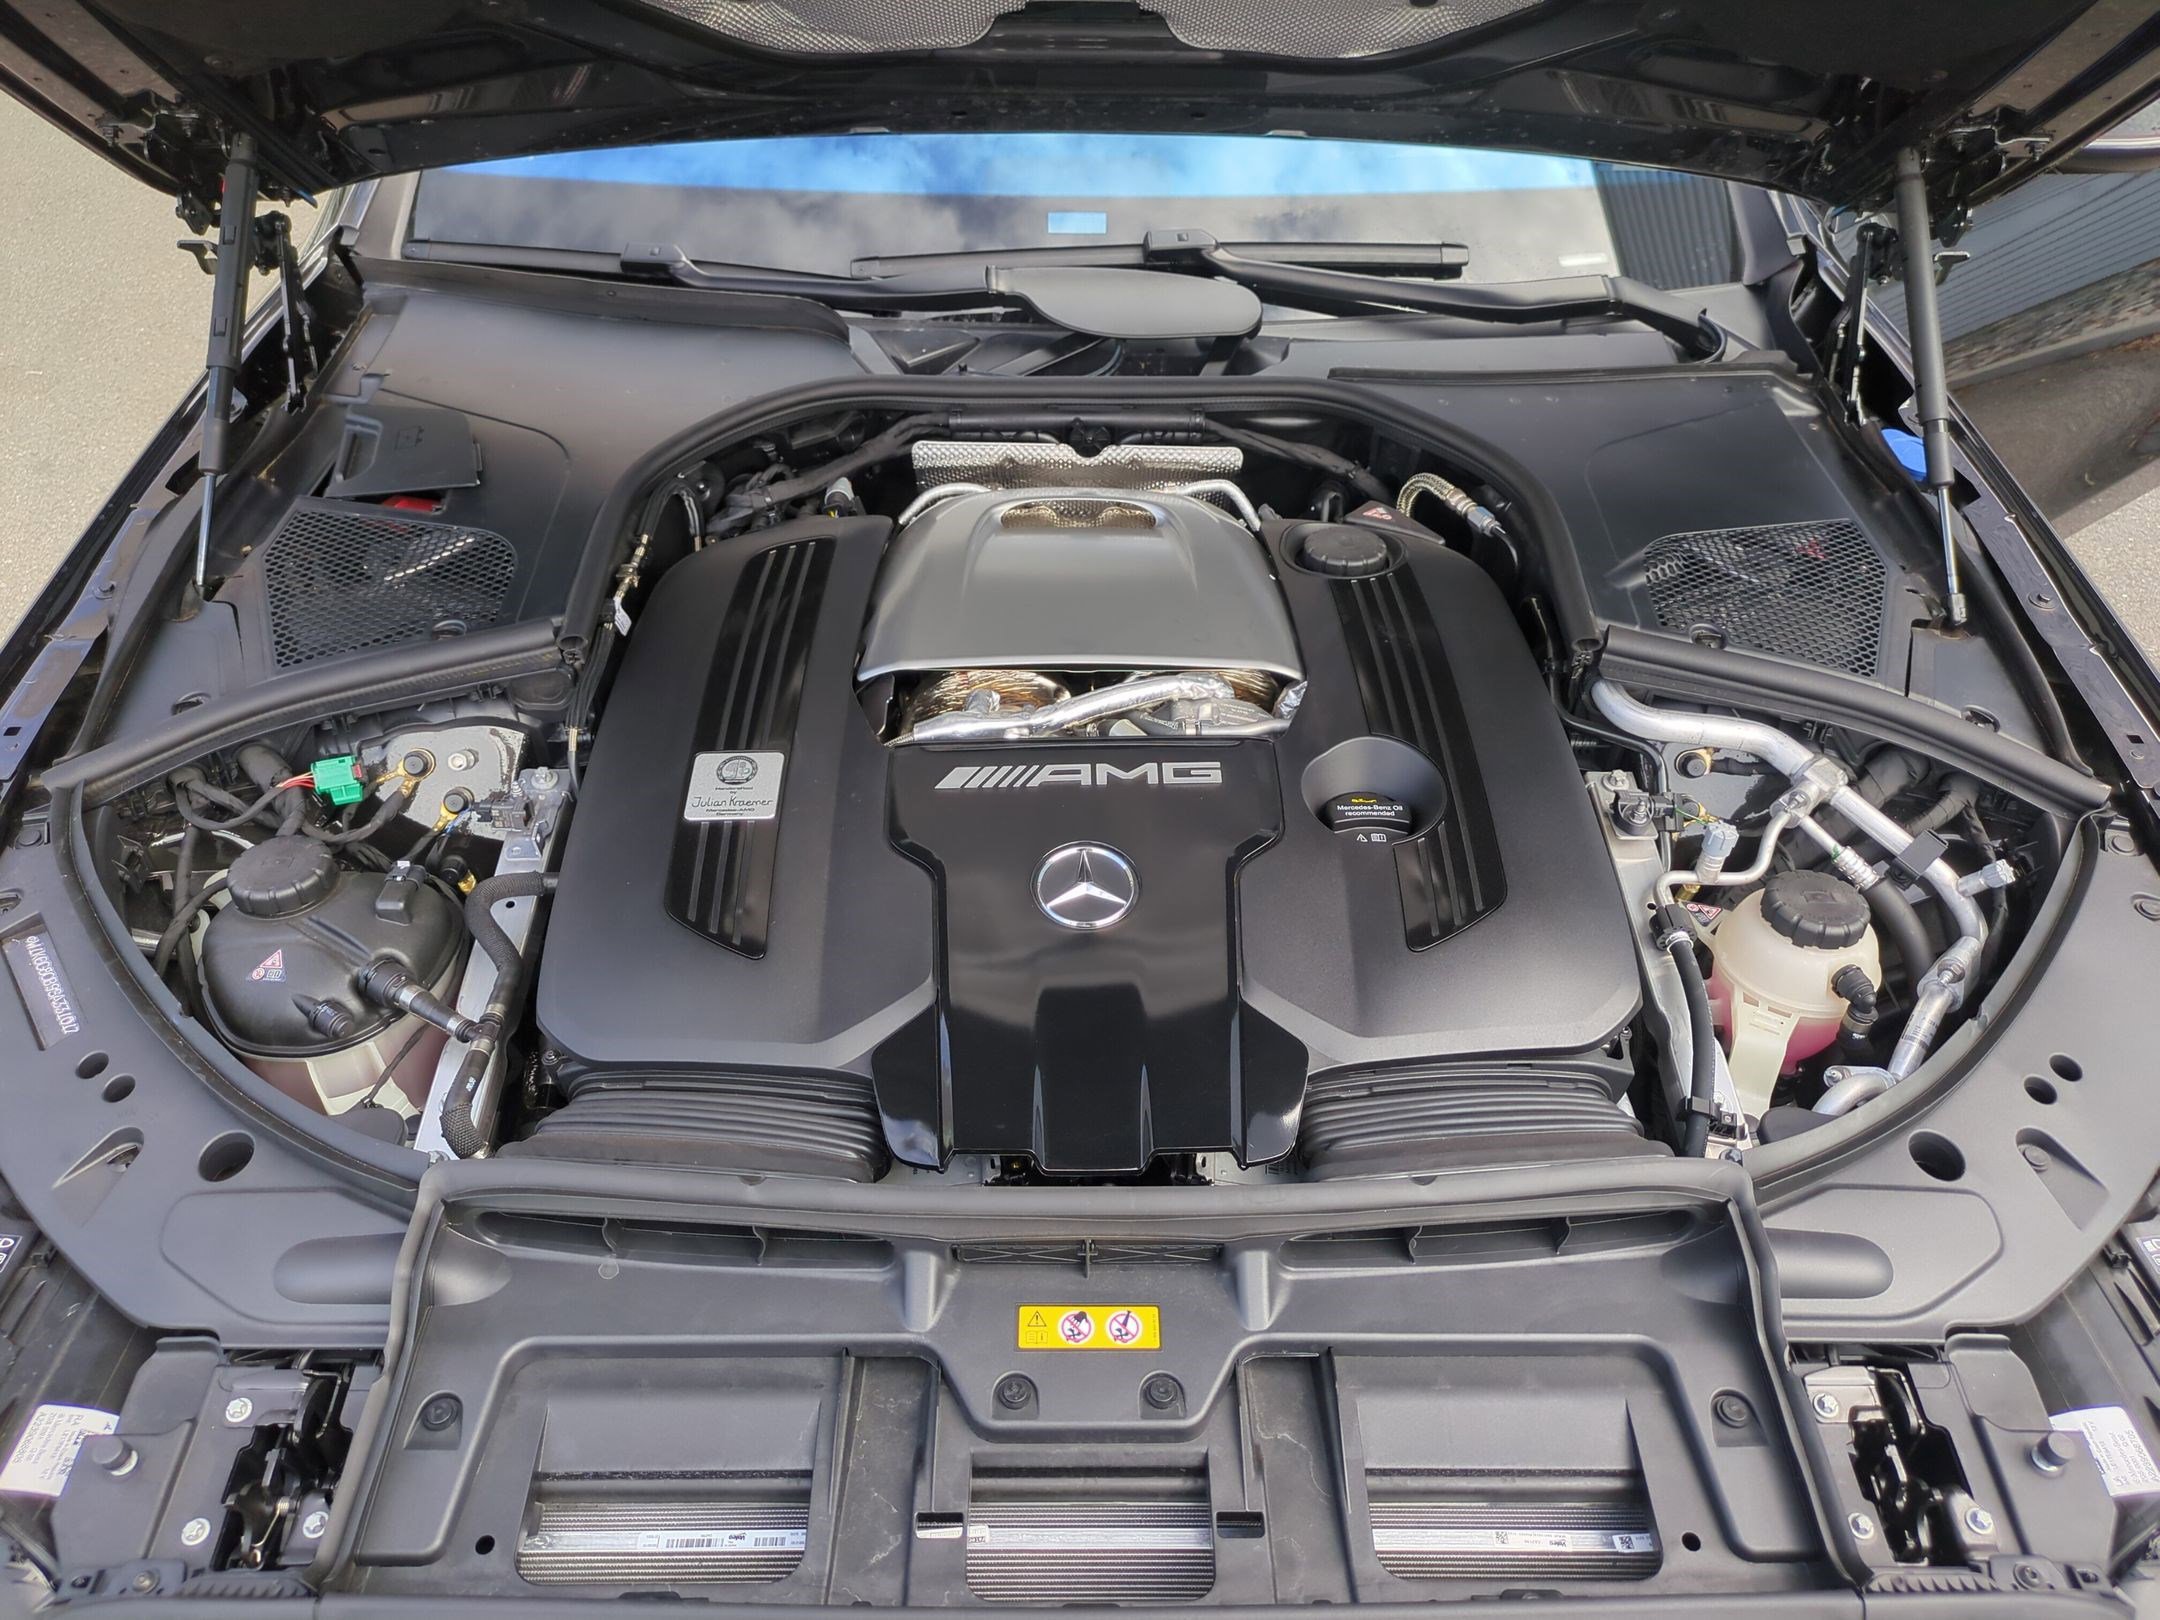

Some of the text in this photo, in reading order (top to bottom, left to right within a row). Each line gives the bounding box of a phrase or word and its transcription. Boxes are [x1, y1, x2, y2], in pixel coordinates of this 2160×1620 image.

[1026, 761, 1223, 789] AMG
[691, 795, 774, 808] Julian Kraemer
